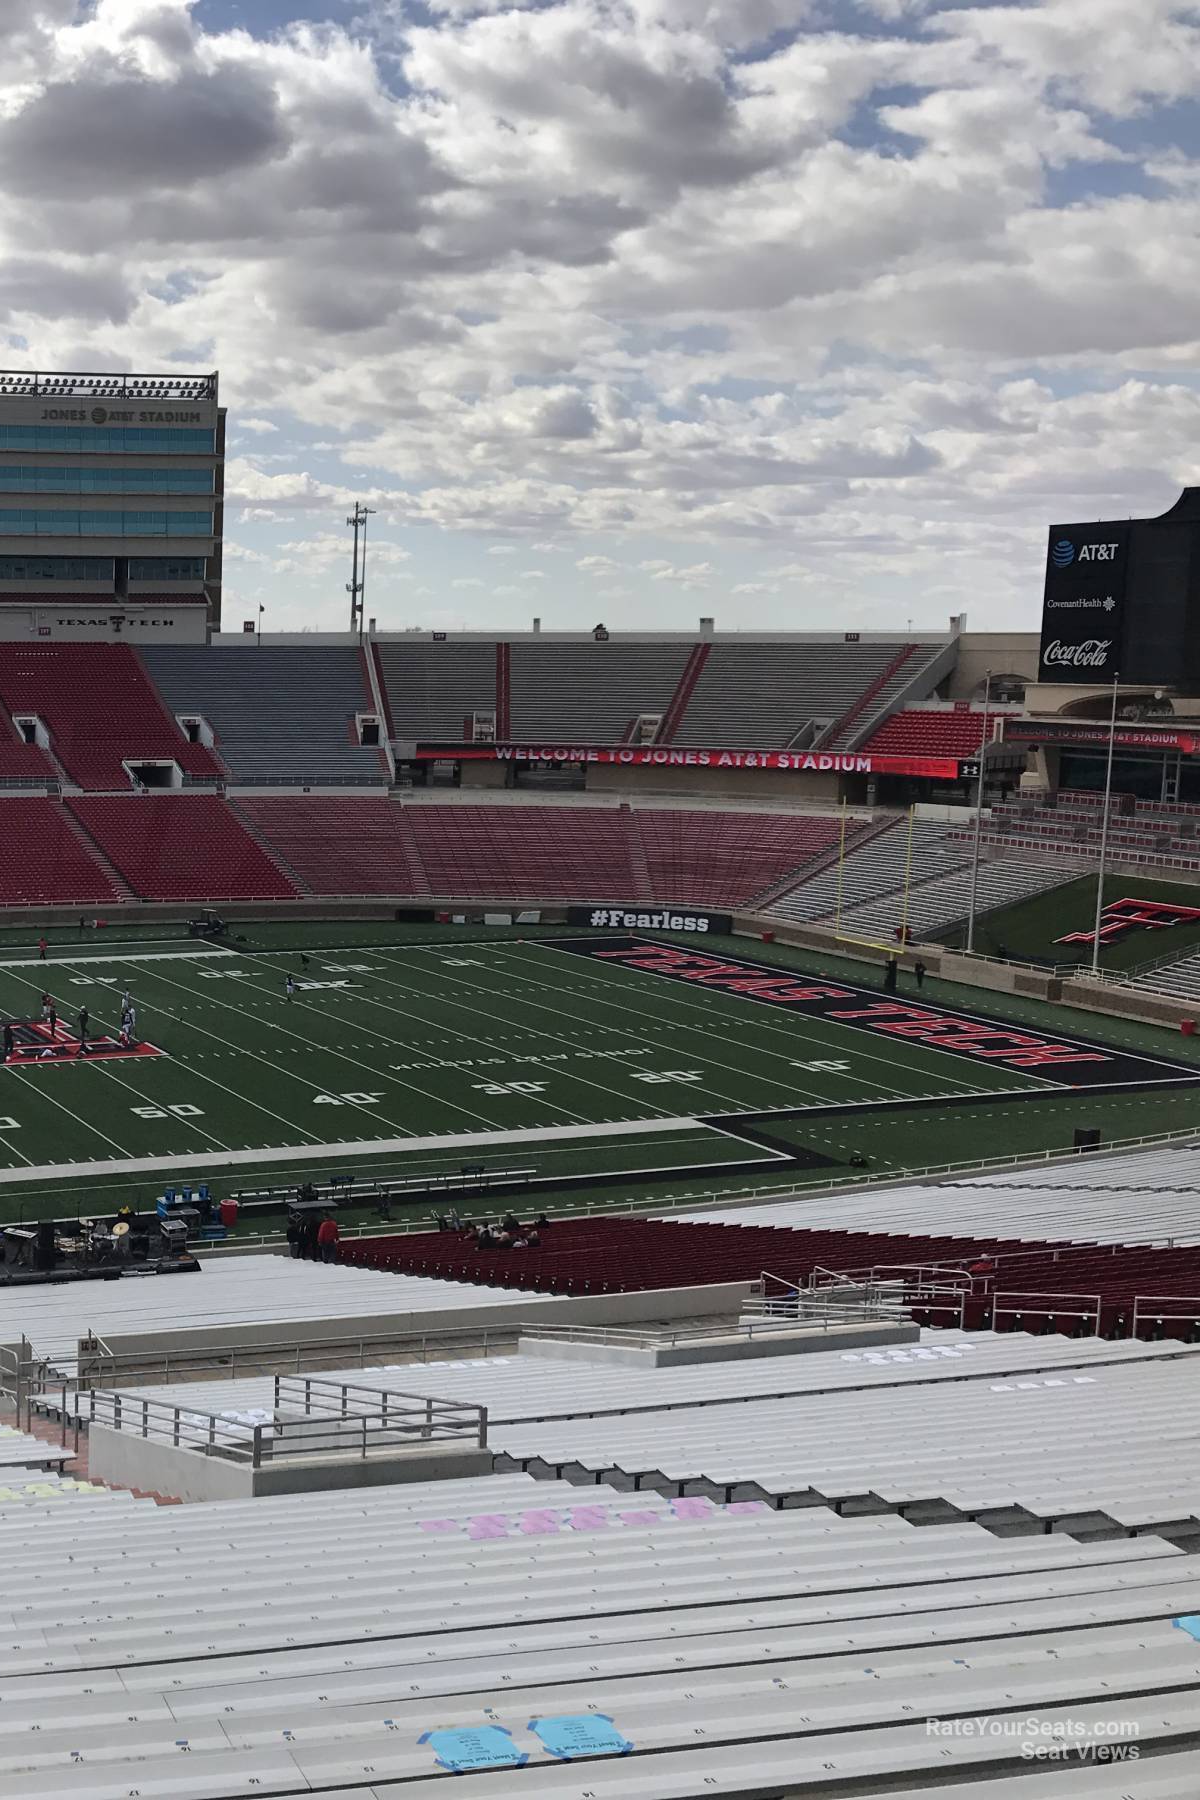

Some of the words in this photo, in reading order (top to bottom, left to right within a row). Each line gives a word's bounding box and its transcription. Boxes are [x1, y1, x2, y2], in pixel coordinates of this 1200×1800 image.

[41, 409, 86, 421] JONES
[109, 411, 135, 421] AT&T
[140, 411, 201, 422] STADIUM
[1078, 544, 1118, 561] AT&T
[56, 618, 107, 626] TEXAS
[128, 619, 174, 627] TECH
[1071, 730, 1103, 739] JONES
[1133, 733, 1178, 743] STADIUM
[495, 746, 599, 761] WELCOME
[609, 749, 634, 762] TO
[641, 750, 710, 765] JONES
[719, 753, 771, 767] AT&T
[778, 754, 873, 772] STADIUM
[590, 910, 709, 932] #Fearless
[591, 945, 859, 1002] TEXAS
[827, 1002, 1114, 1067] TECH
[630, 1070, 695, 1084] 20
[472, 1081, 540, 1096] 30
[312, 1091, 380, 1106] 40
[130, 1103, 205, 1119] 50
